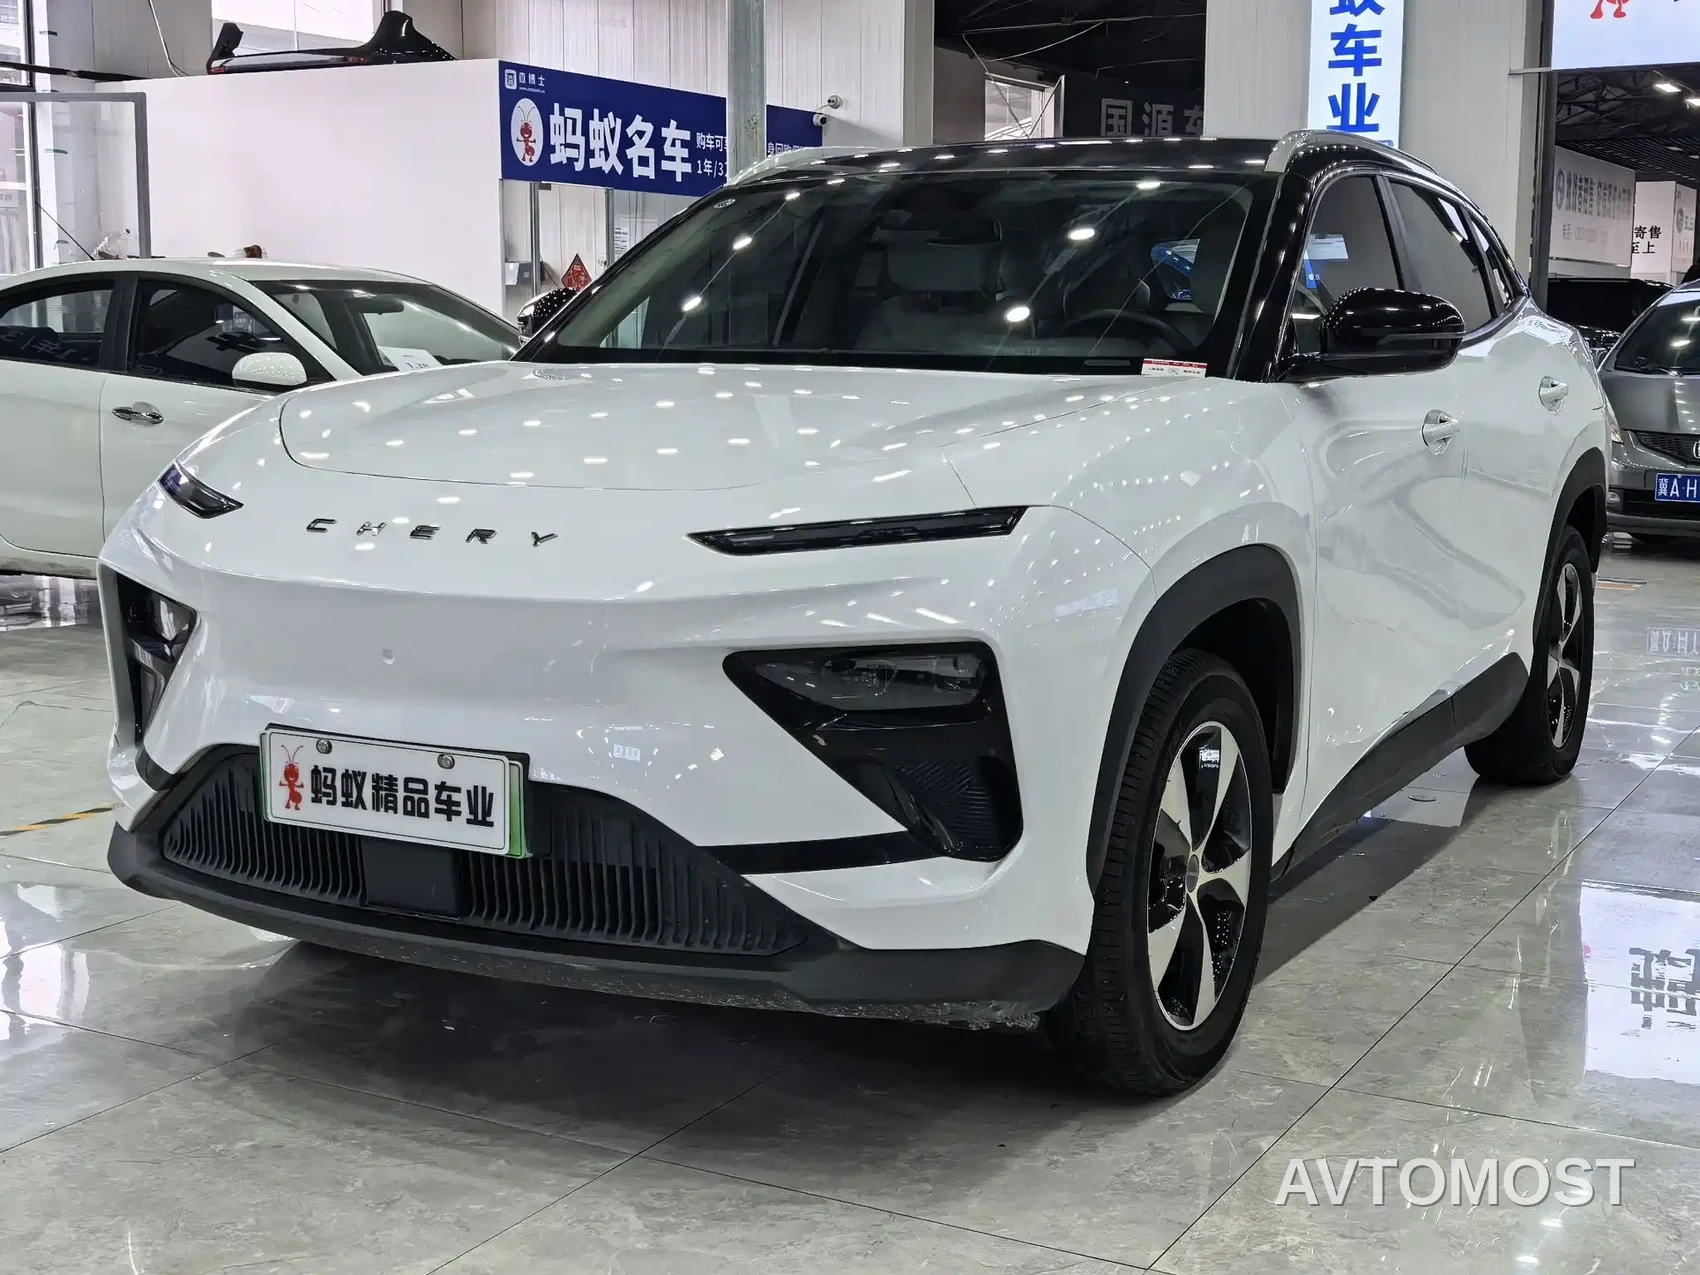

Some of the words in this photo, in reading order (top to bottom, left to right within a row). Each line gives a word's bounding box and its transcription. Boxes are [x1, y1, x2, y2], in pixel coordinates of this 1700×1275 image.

[549, 102, 692, 182] 蚂蚁名车
[696, 132, 728, 152] 购车可
[697, 159, 728, 178] 1年/3
[306, 518, 558, 547] CHERY
[310, 764, 495, 828] 蚂蚁精品车业
